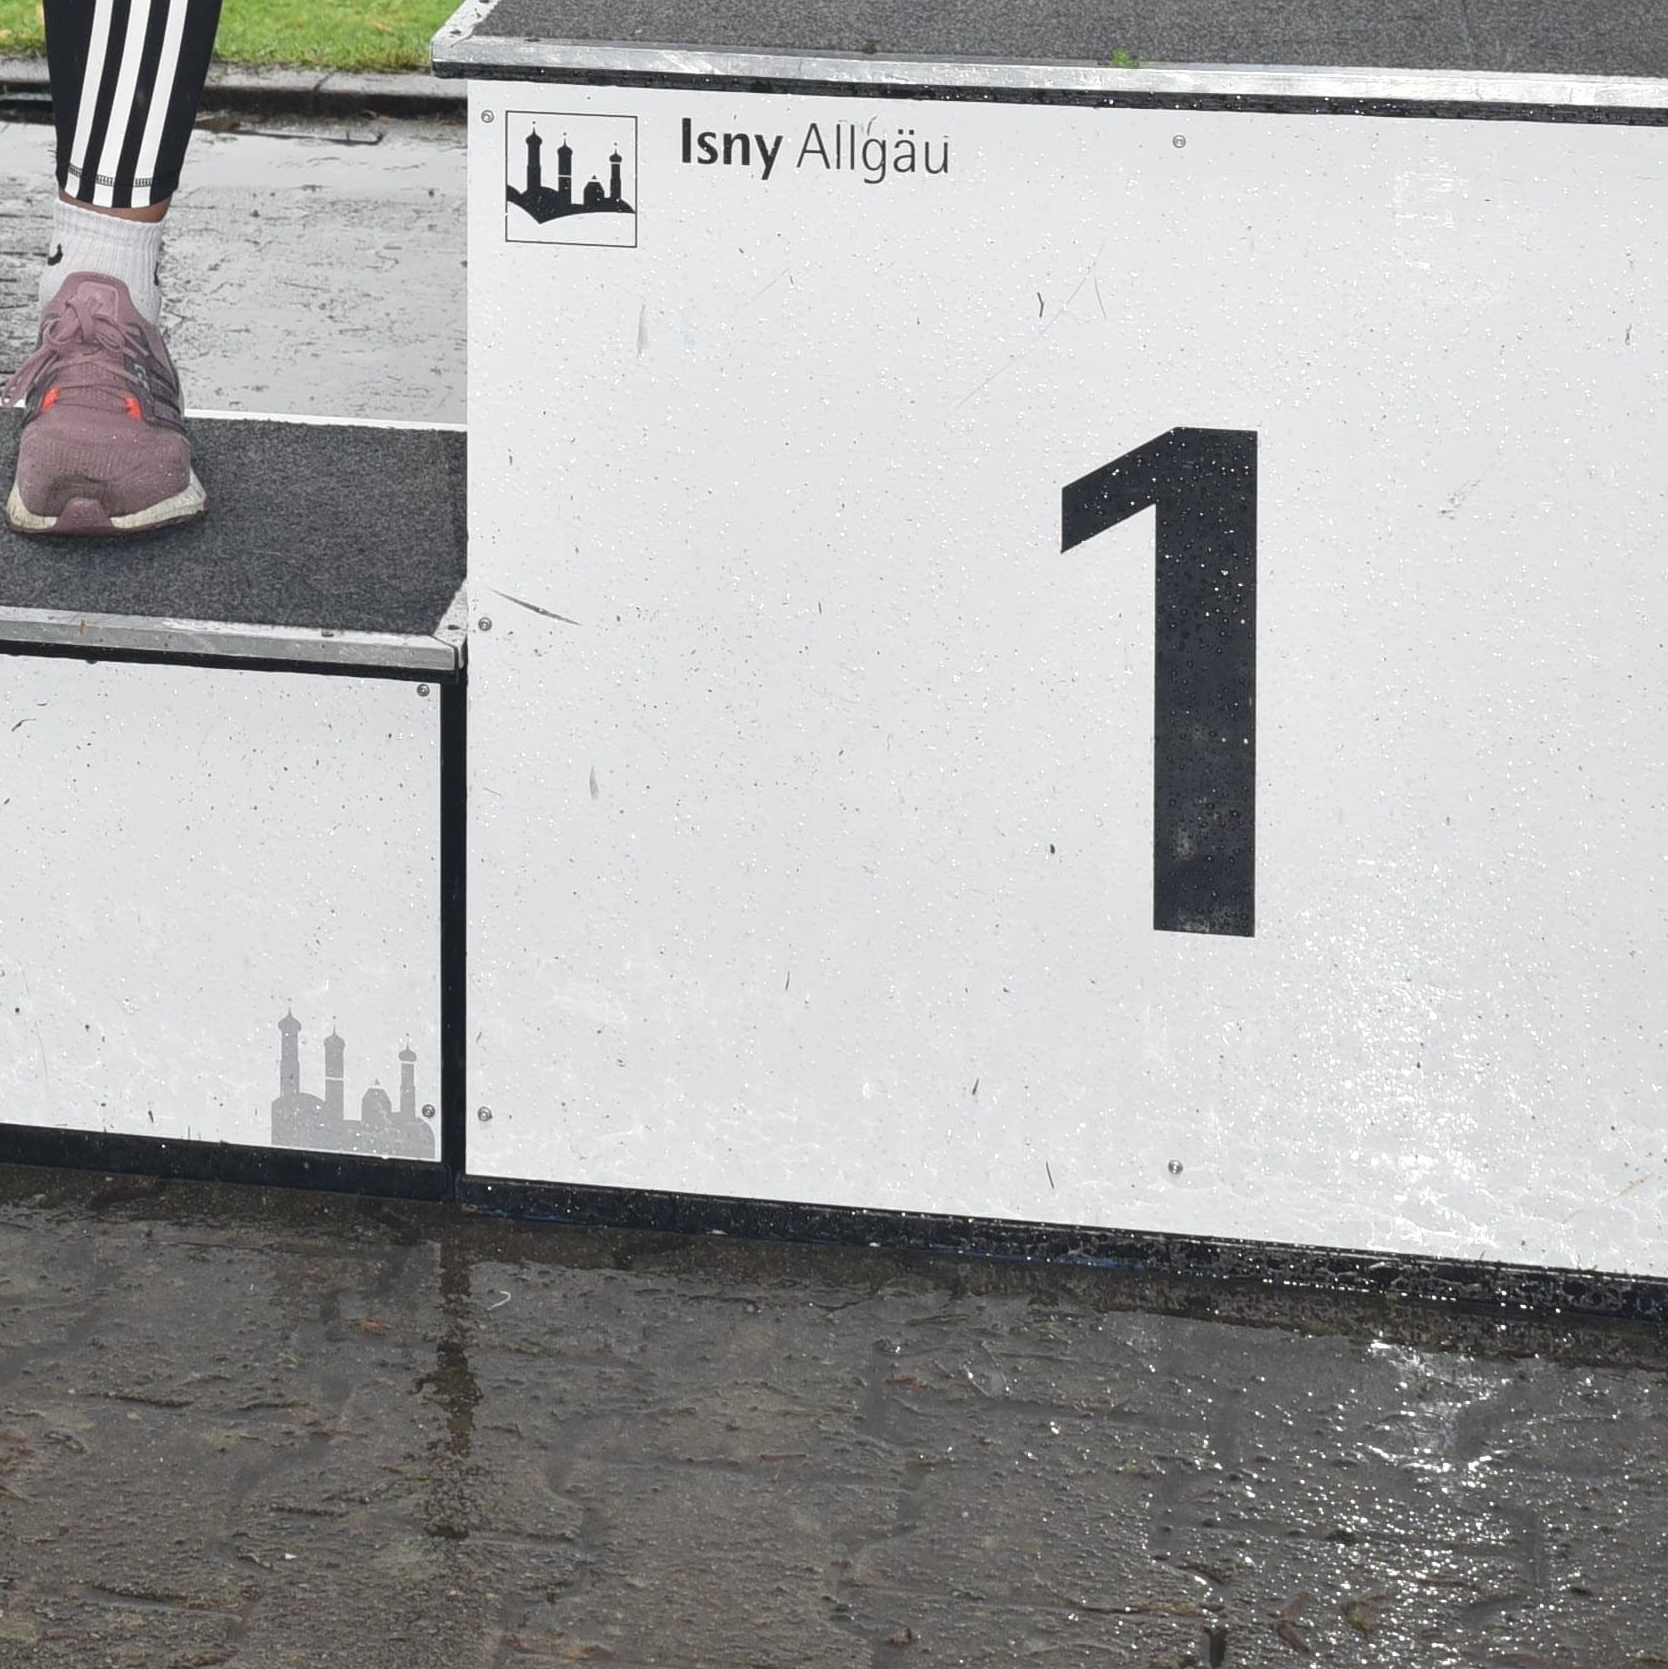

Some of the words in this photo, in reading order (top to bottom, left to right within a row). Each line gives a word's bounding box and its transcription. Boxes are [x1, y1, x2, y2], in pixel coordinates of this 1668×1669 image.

[681, 118, 783, 180] Isny
[797, 122, 950, 184] Allgäu
[1060, 426, 1258, 938] 1
